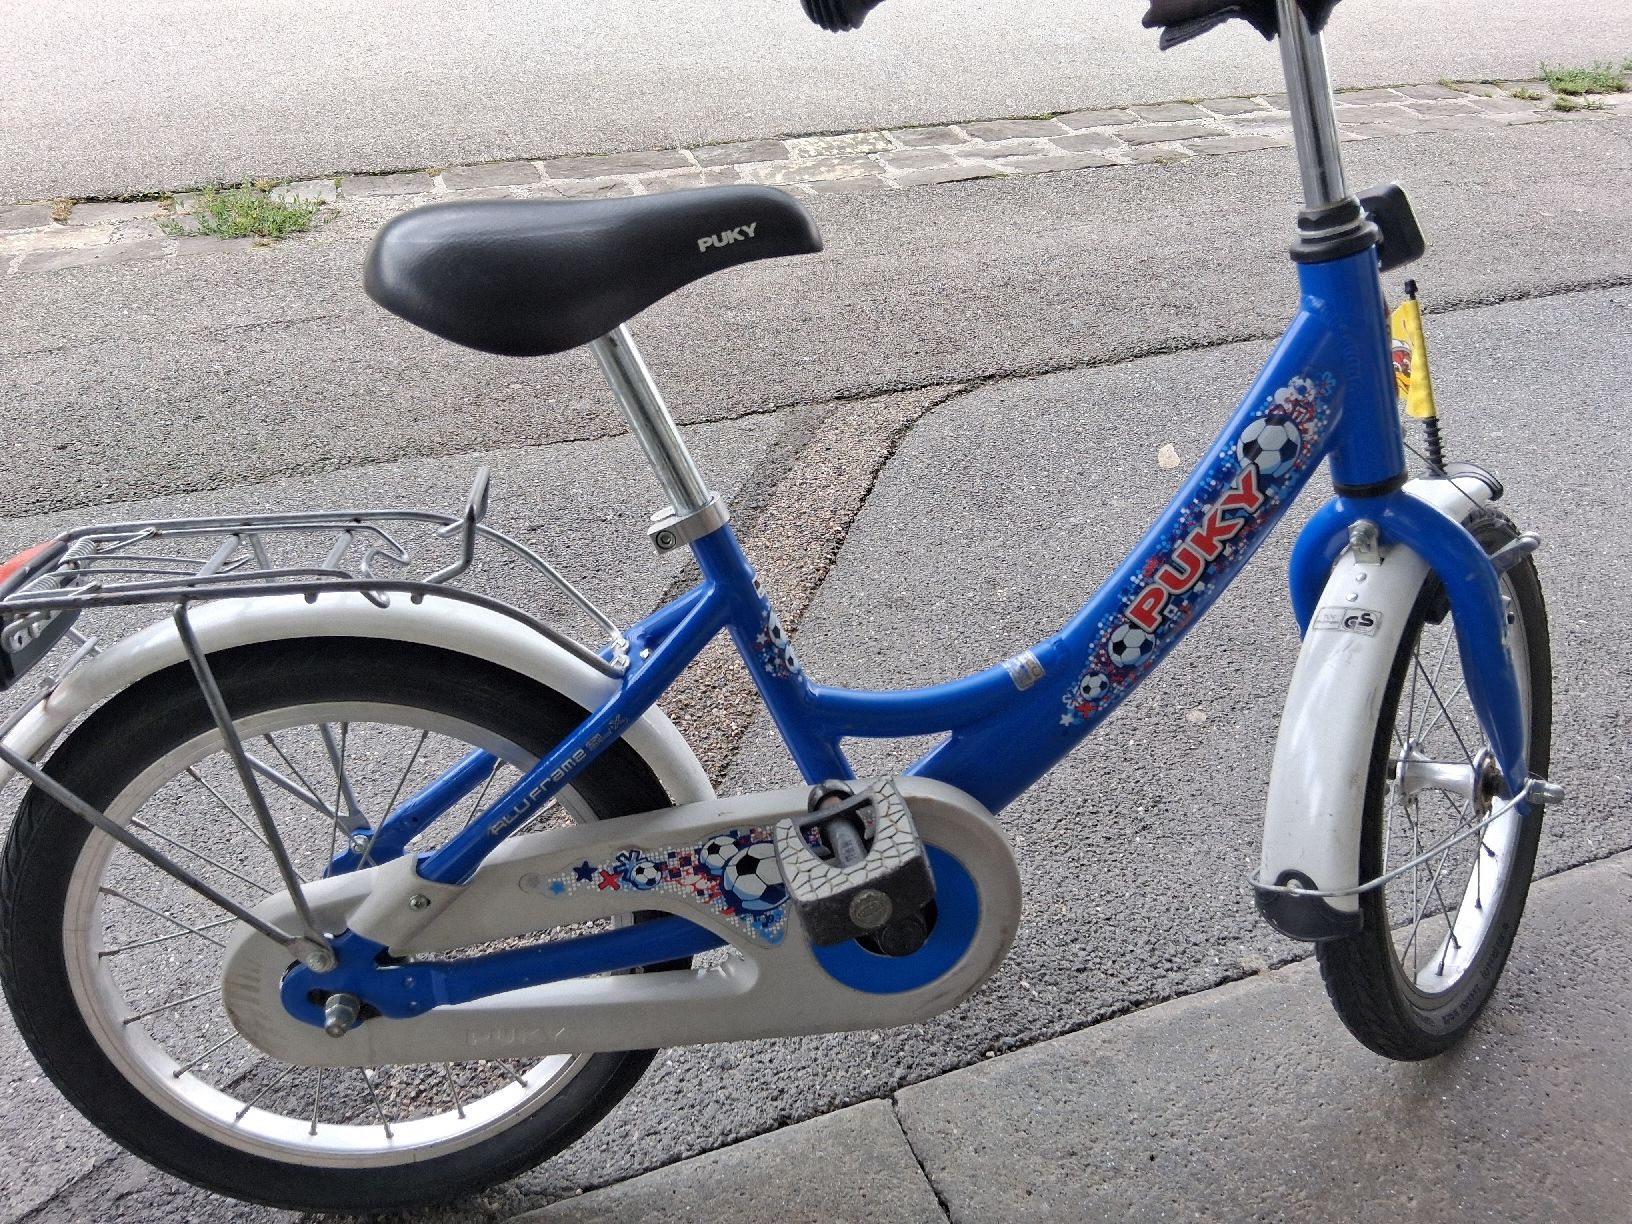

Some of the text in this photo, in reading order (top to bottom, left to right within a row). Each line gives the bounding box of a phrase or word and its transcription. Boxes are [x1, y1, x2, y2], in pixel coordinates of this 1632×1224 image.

[697, 221, 757, 253] PUKY
[1126, 463, 1264, 632] PUKY
[488, 798, 531, 836] ALU
